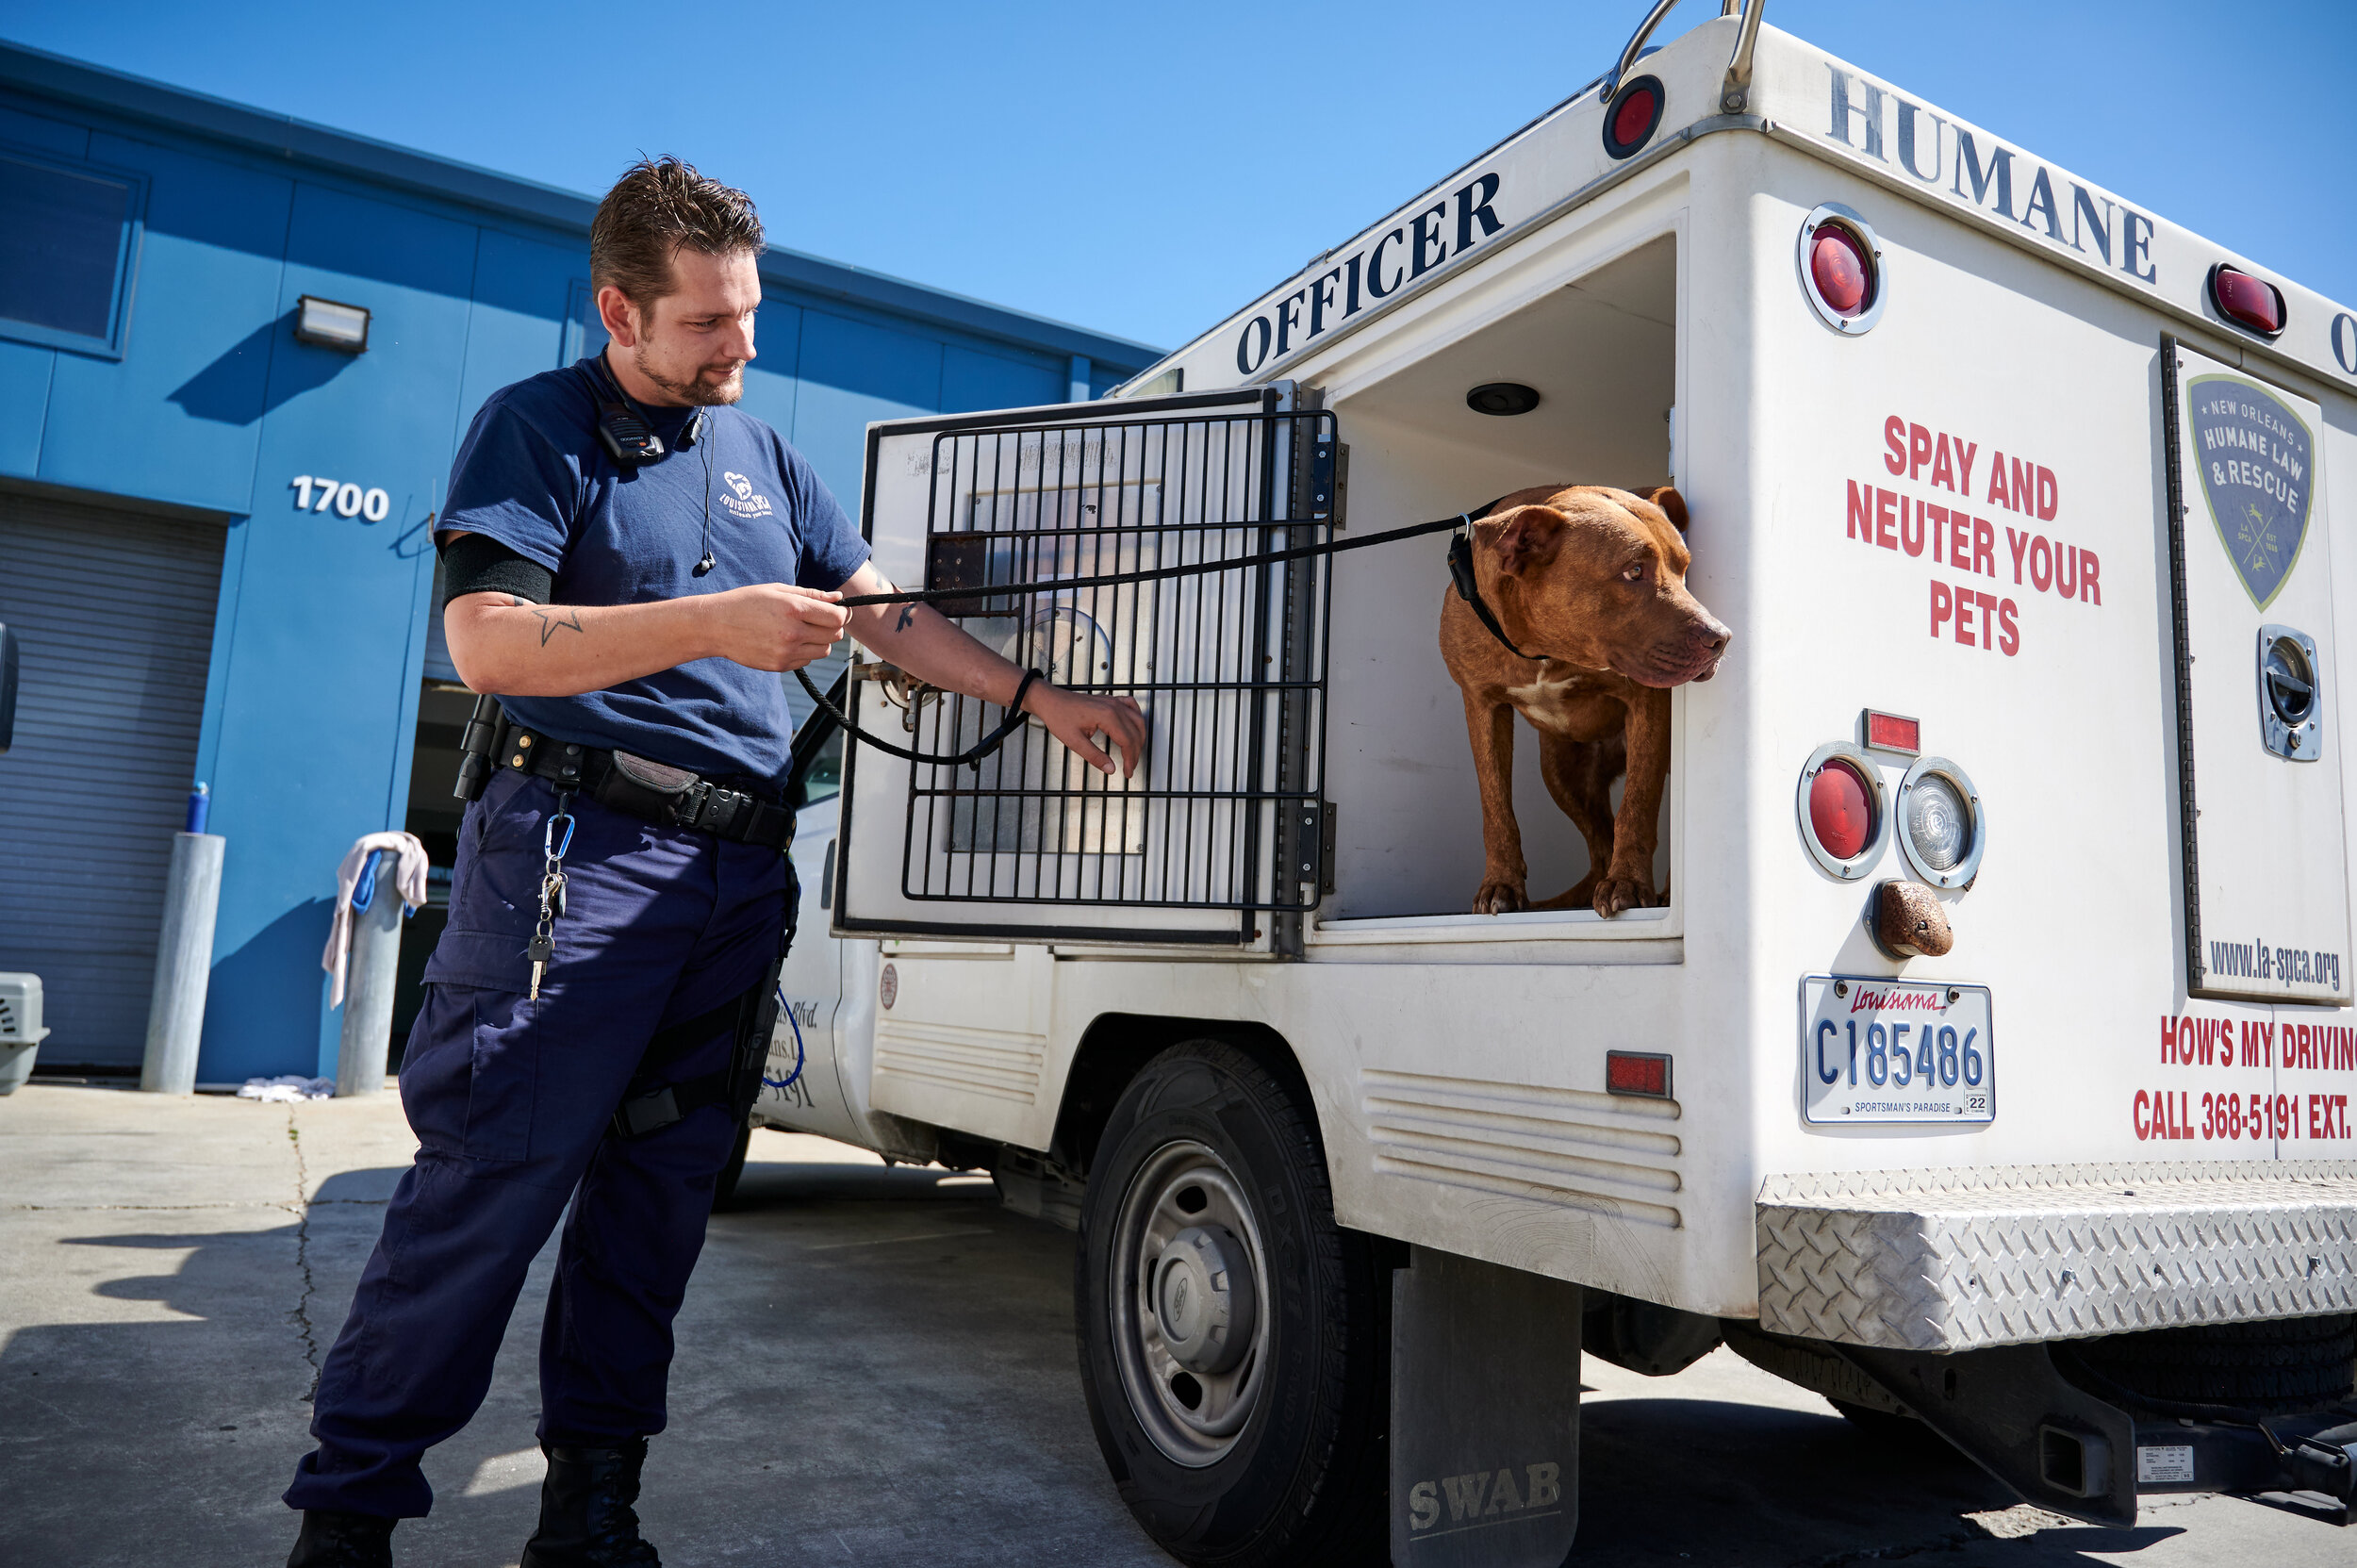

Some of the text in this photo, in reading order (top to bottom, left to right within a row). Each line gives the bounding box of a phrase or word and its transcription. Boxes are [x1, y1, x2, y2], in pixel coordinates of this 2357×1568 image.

[1823, 61, 2156, 285] HUMANE
[1236, 173, 1505, 374] OFFICER
[2211, 400, 2294, 445] NEW ORLEANS
[1884, 415, 2058, 521] SPAY AND
[2204, 426, 2303, 482] HUMANE LAW
[292, 474, 389, 521] 1700
[719, 493, 758, 513] LOUISIANA
[1847, 478, 2102, 606] NEUTER YOUR
[2237, 532, 2252, 543] SPCA
[1930, 579, 2019, 657] PETS
[2210, 937, 2340, 991] www.la-spca.org
[1851, 984, 1946, 1014] Louisiana
[1818, 1019, 1983, 1087] C185486
[2161, 1015, 2357, 1071] HOW'S MY DRIVIN
[1854, 1102, 1951, 1113] SPORTSMAN'S PARADISE
[1970, 1098, 1986, 1109] 22
[2134, 1089, 2351, 1141] CALL 368-5191 EXT.
[1409, 1462, 1560, 1530] SWAB
